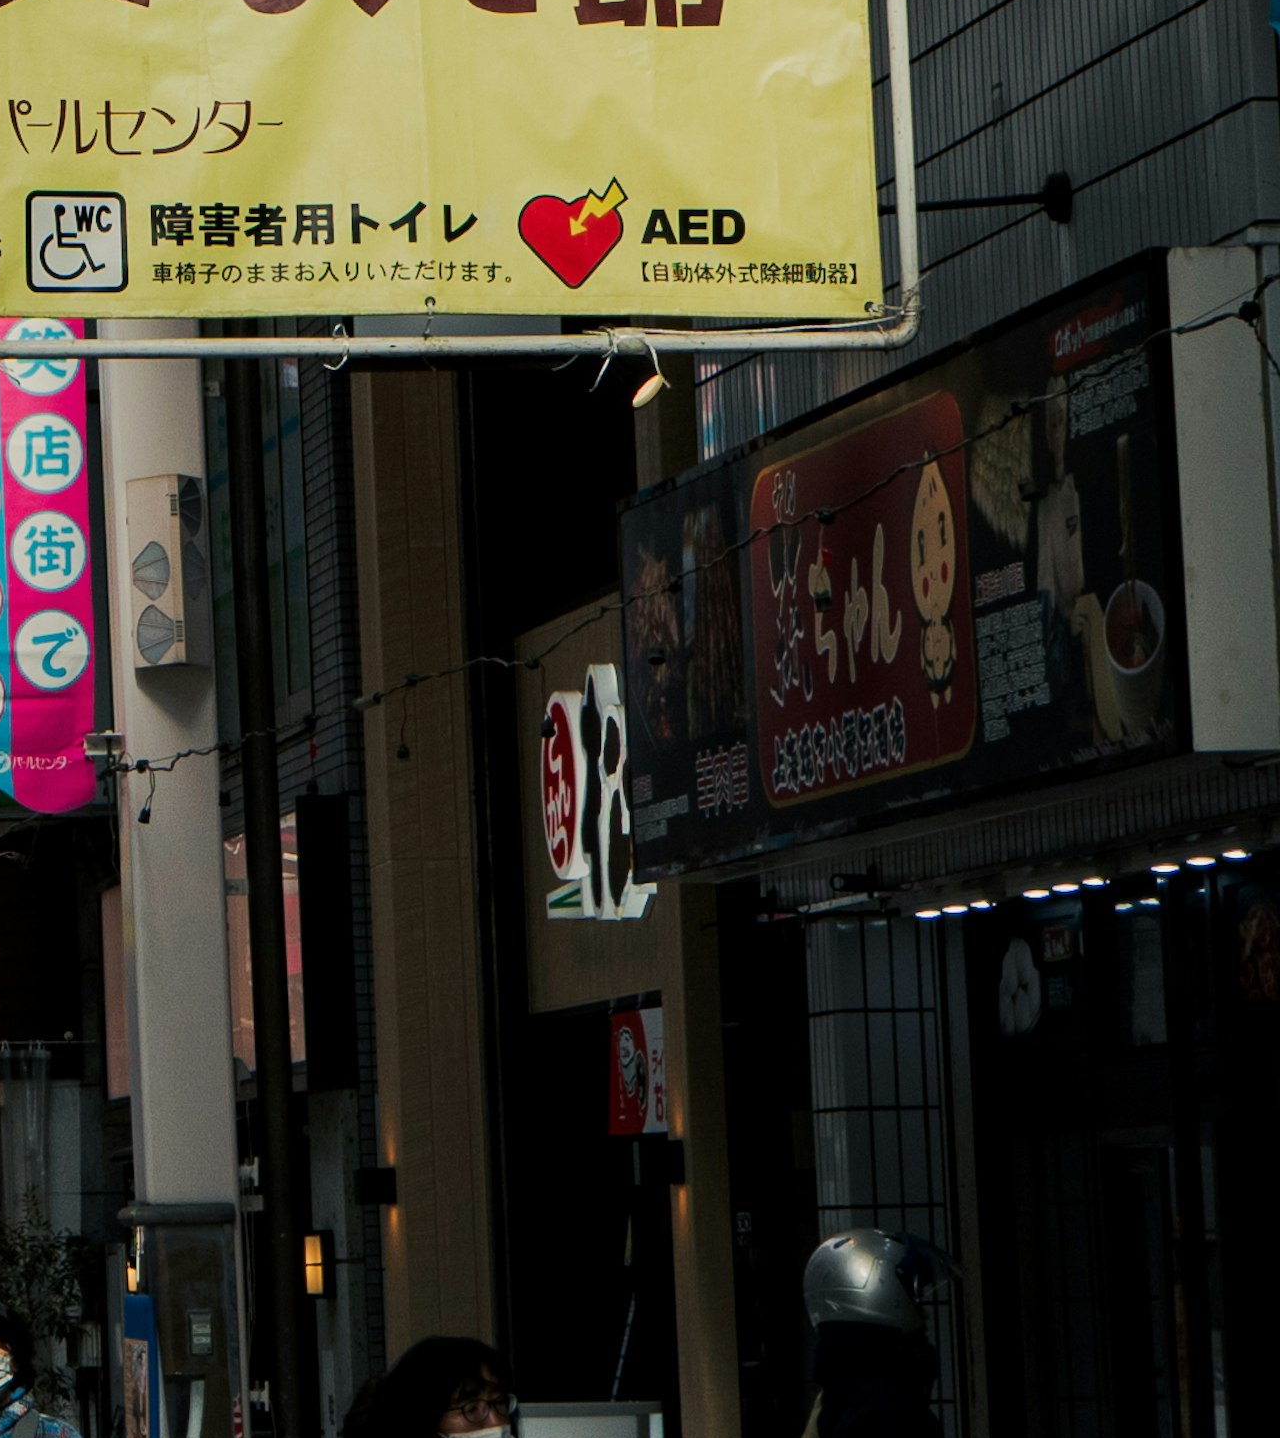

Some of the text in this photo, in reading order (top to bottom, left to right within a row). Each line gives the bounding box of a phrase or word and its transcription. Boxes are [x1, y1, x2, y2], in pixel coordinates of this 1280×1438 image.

[74, 205, 113, 233] WC
[149, 202, 478, 248] 障害者用トイレ
[641, 208, 746, 246] AED
[151, 259, 514, 286] 車椅子のままお入りいただけます。
[16, 325, 79, 679] 笑店街で
